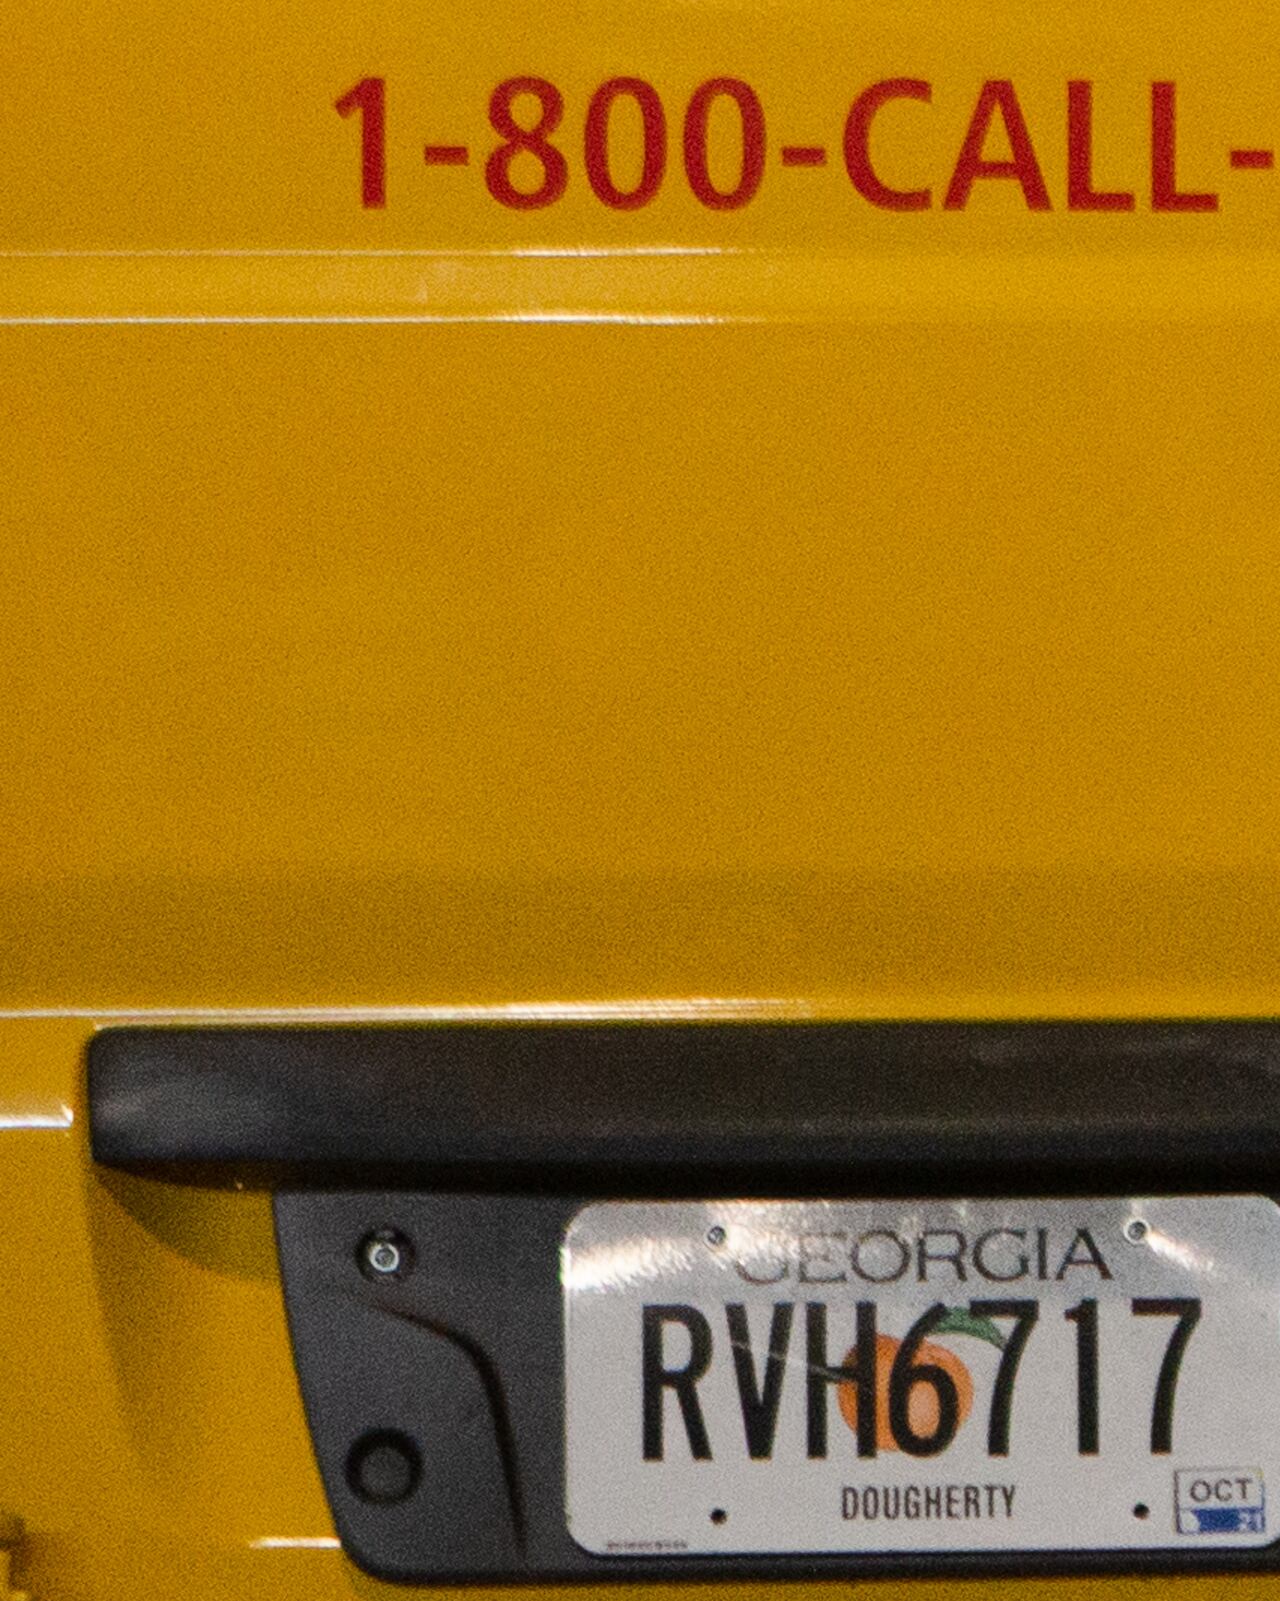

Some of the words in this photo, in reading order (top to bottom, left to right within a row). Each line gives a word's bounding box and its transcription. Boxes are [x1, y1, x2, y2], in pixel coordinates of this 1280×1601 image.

[733, 1226, 1114, 1286] GEORGIA
[641, 1297, 1203, 1461] RVH6717
[840, 1483, 1017, 1522] DOUGHERTY
[1190, 1478, 1254, 1504] OCT
